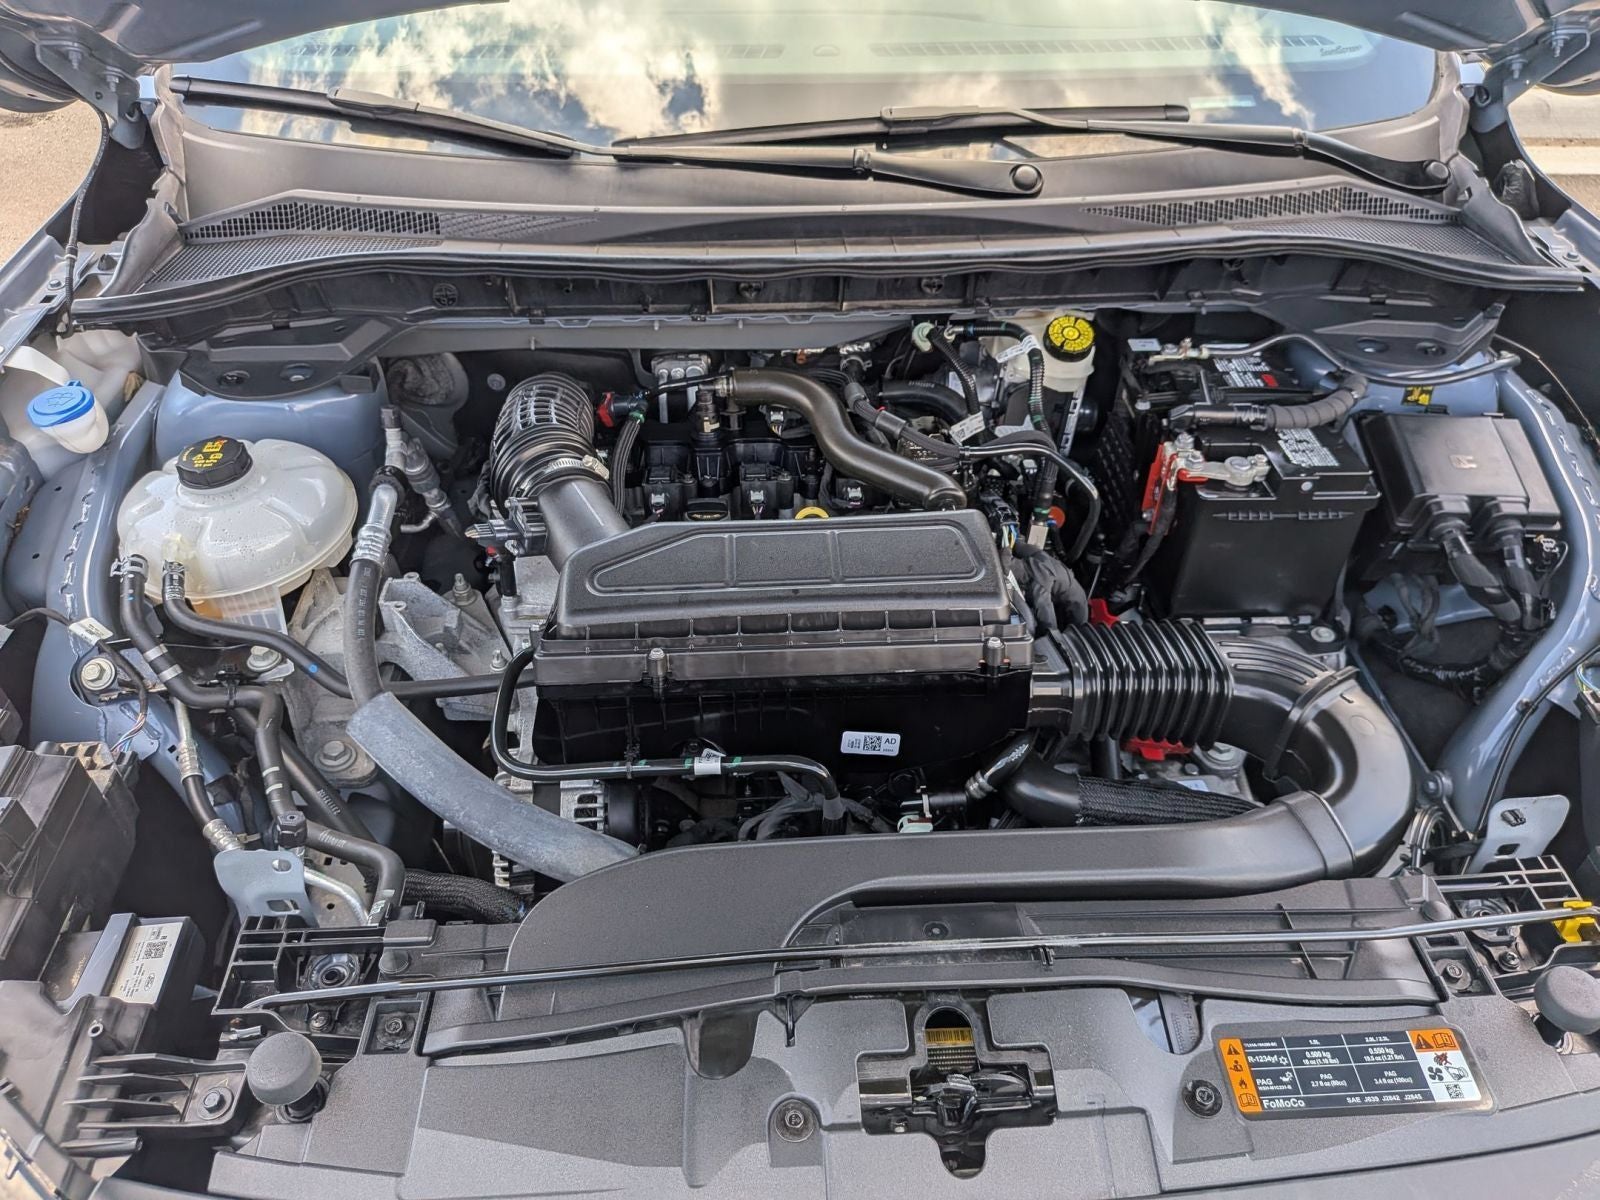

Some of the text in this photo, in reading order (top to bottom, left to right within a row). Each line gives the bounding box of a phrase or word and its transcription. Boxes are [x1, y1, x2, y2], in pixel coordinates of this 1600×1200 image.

[1322, 1051, 1331, 1059] kg
[1385, 1046, 1395, 1055] kg
[1247, 1055, 1278, 1064] R-1234yf
[1262, 1098, 1306, 1109] FoMoCo
